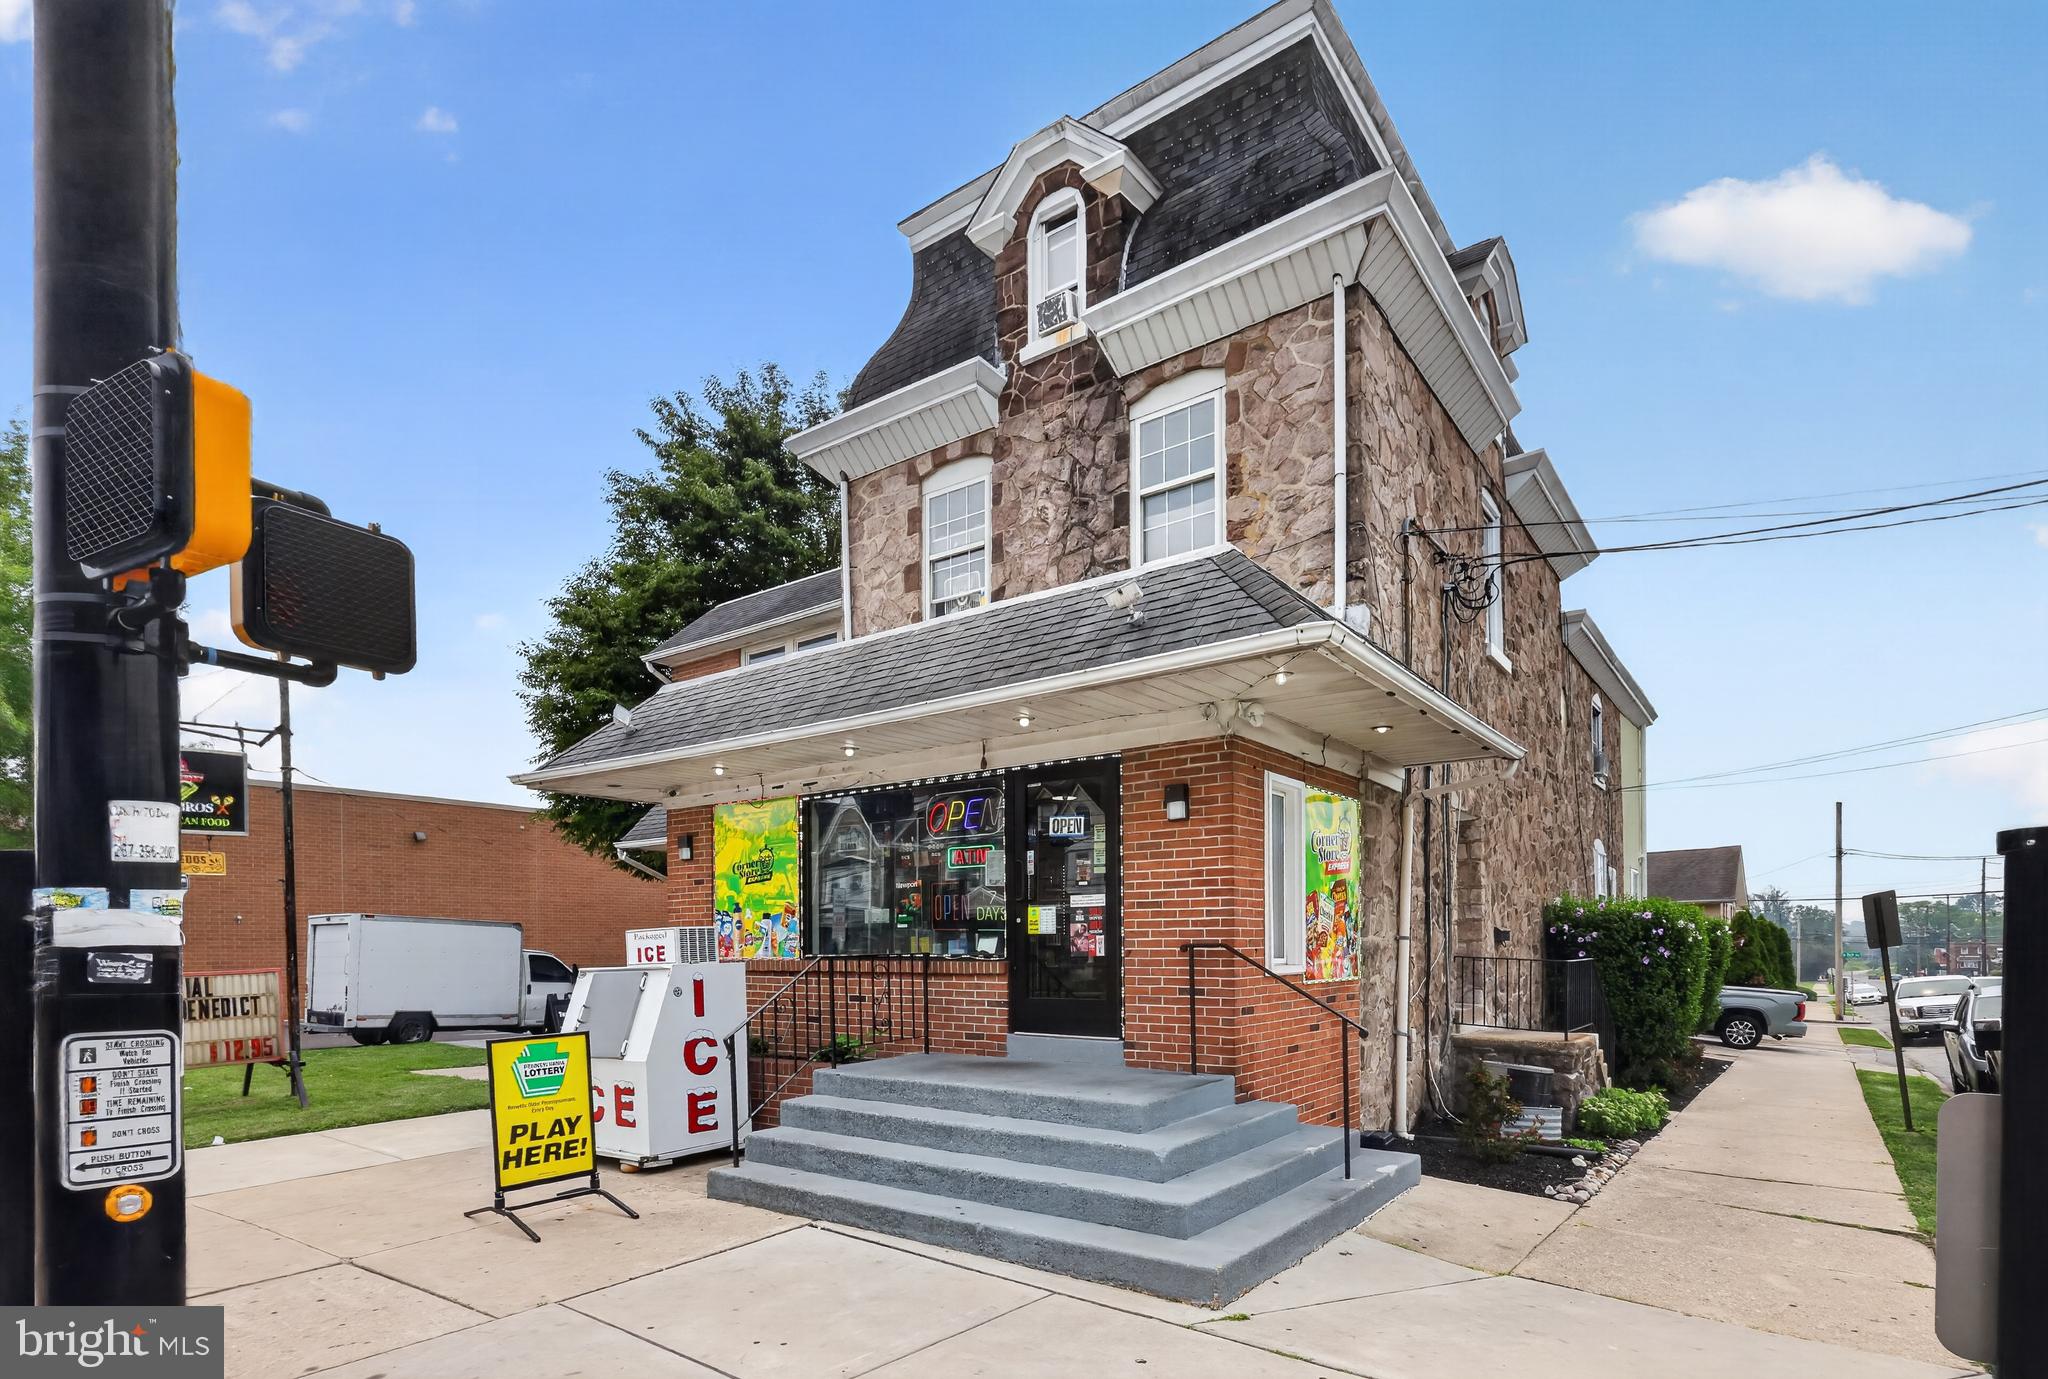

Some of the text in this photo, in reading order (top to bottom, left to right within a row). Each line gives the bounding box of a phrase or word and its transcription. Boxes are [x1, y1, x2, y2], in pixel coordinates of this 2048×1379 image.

[929, 798, 999, 832] OPEN
[200, 817, 230, 827] FOOD
[1052, 818, 1082, 834] OPEN
[1311, 829, 1339, 853] Corner
[1318, 847, 1340, 863] Store
[732, 860, 760, 875] Corner
[739, 869, 760, 880] Store
[895, 880, 918, 889] Newport
[934, 895, 970, 921] OPEN
[976, 906, 1006, 921] DAYS
[634, 931, 668, 940] Packaged
[637, 944, 666, 963] ICE
[105, 1039, 165, 1049] START CROSSING
[683, 972, 718, 1134] ICE
[123, 1057, 149, 1065] Vehicles
[112, 1068, 158, 1079] DON'T START
[524, 1066, 566, 1078] LOTTERY
[110, 1078, 162, 1088] Finish Crossing
[129, 1086, 152, 1094] Started
[106, 1096, 166, 1108] TIME REMAINING
[117, 1106, 137, 1115] Finish
[141, 1104, 166, 1113] Crossing
[112, 1126, 160, 1138] DON'T CROSS
[509, 1115, 583, 1145] PLAY
[91, 1149, 152, 1163] PUSH BUTTON
[502, 1138, 588, 1171] HERE!
[101, 1164, 144, 1176] TO CROSS
